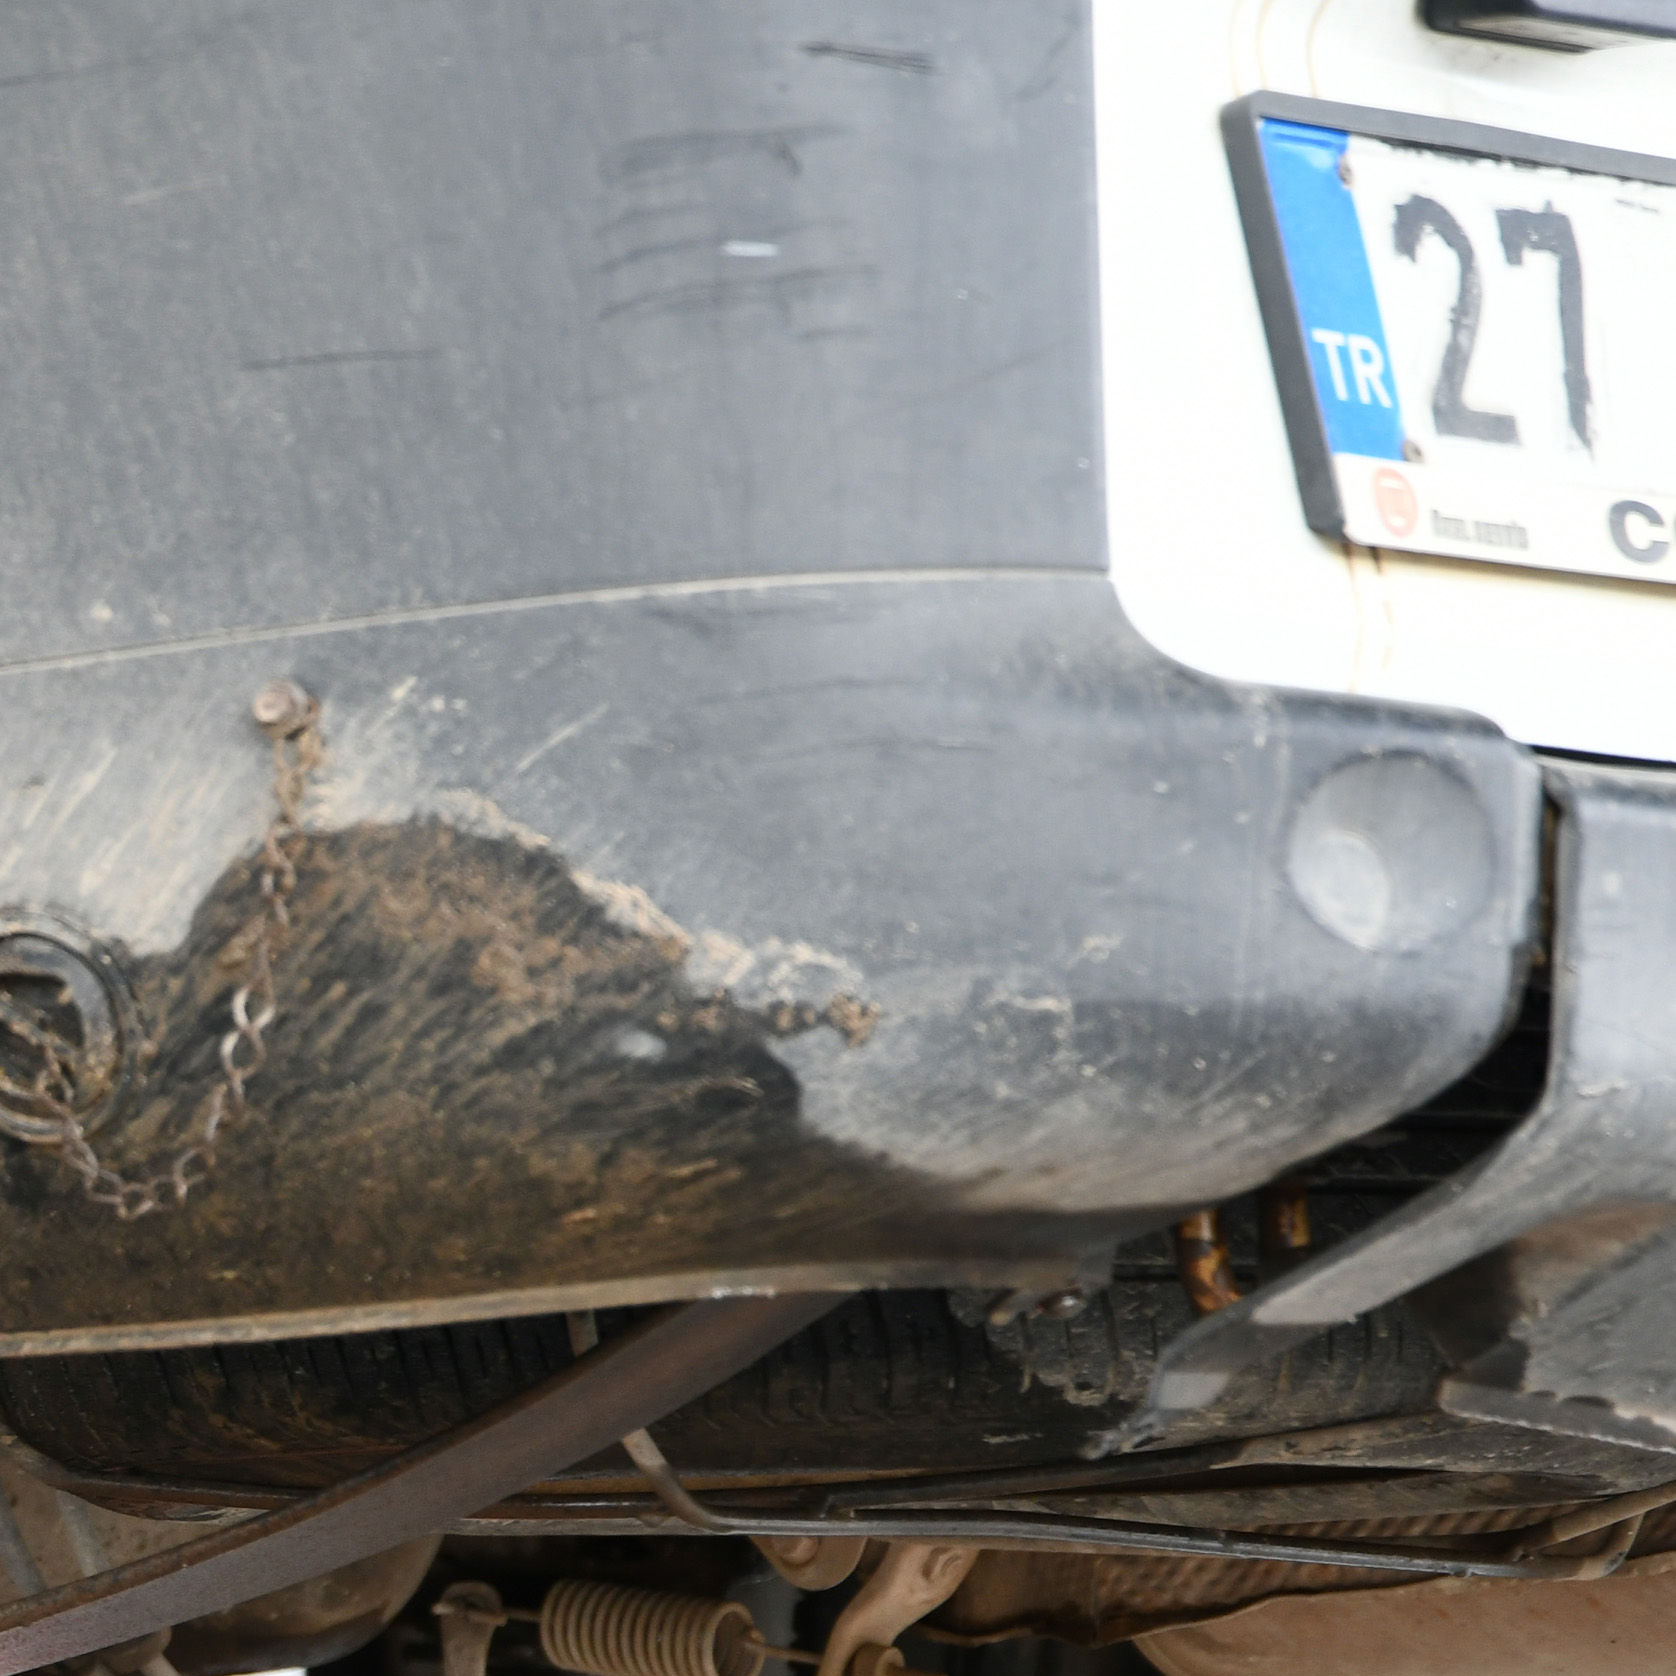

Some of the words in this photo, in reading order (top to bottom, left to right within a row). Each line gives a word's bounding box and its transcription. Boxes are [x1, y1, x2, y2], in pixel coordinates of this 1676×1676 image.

[1312, 328, 1393, 409] TR
[1392, 192, 1596, 464] 27
[1609, 499, 1676, 565] C
